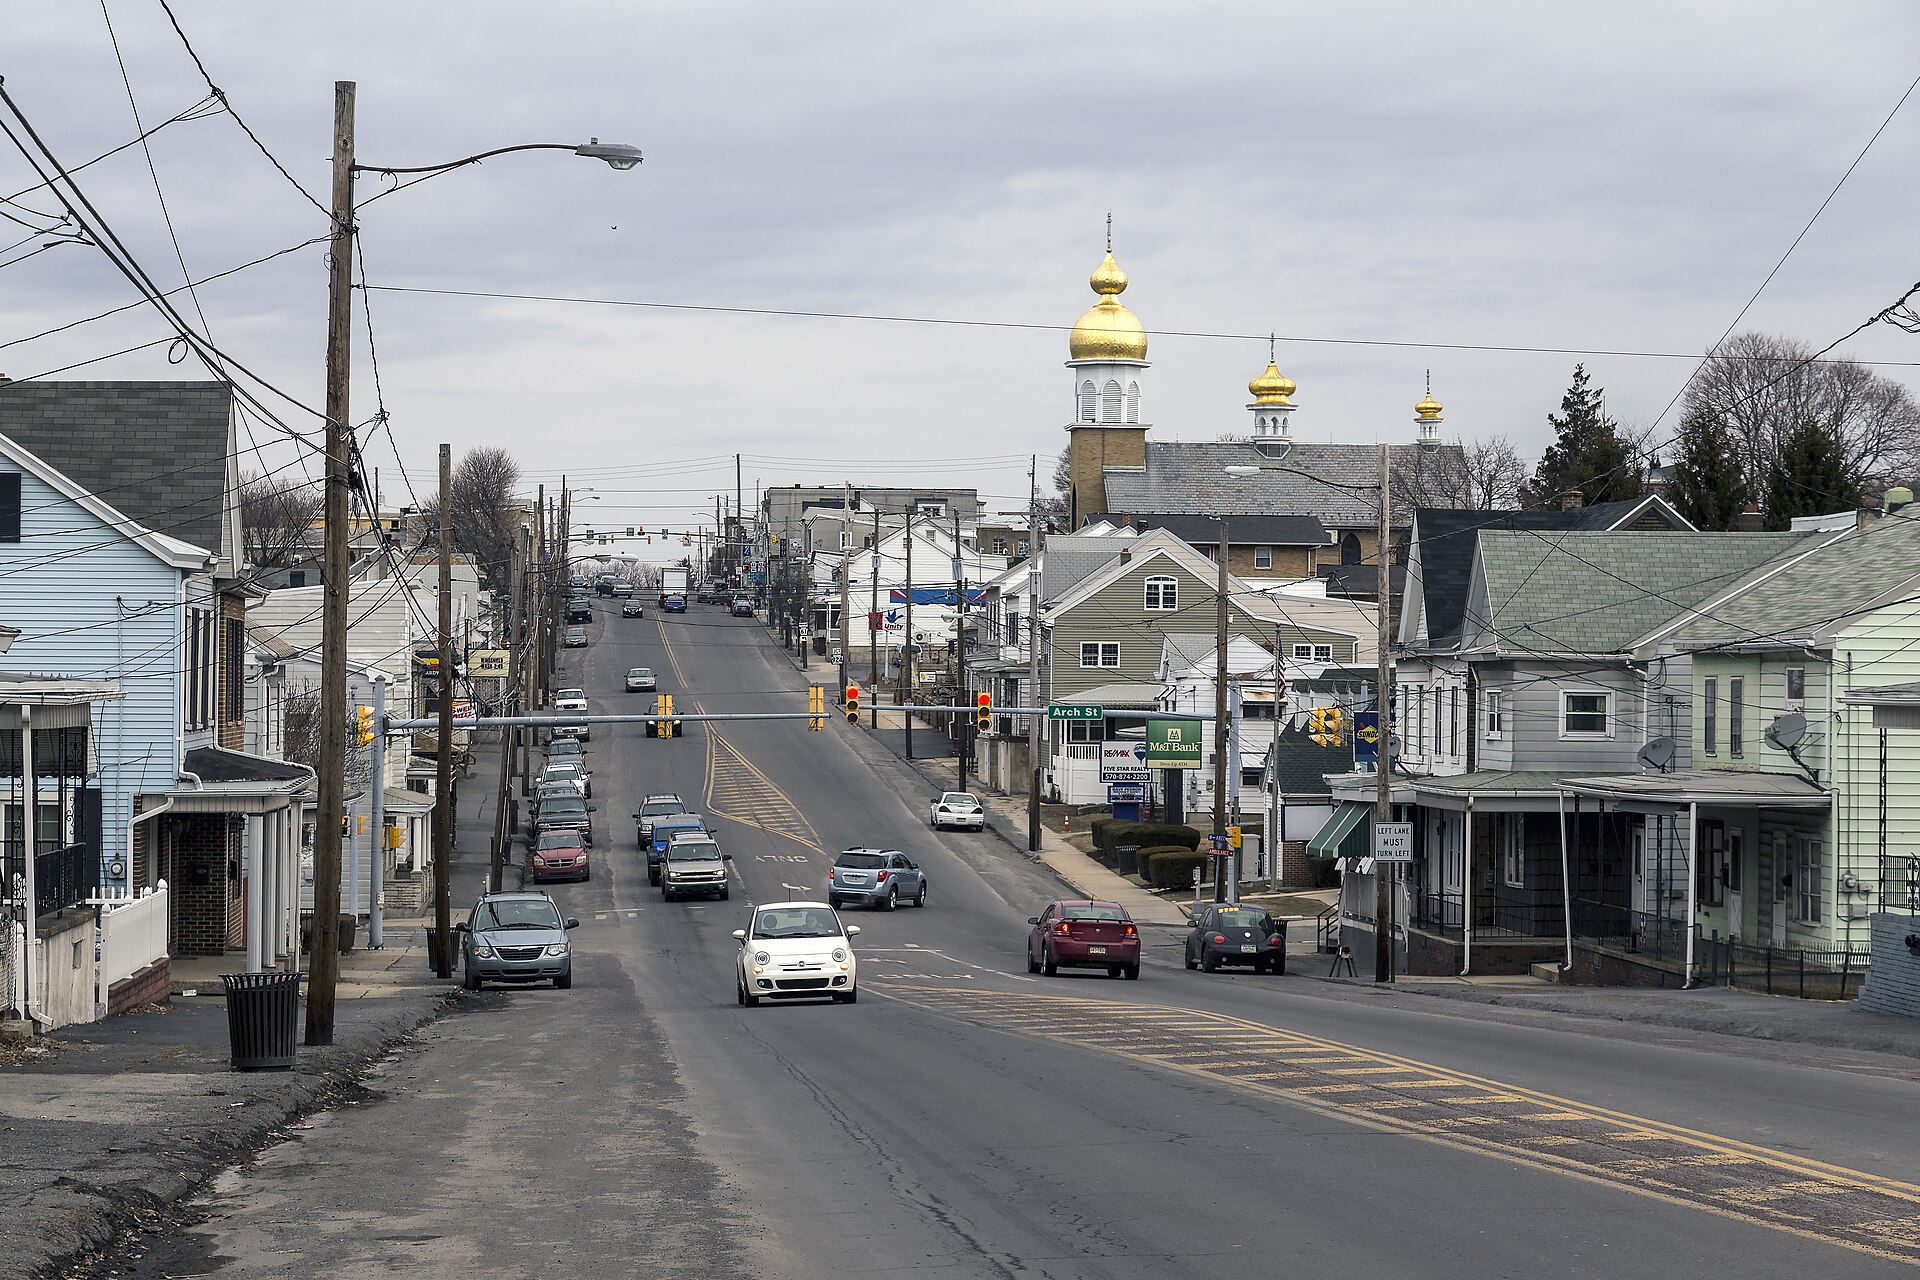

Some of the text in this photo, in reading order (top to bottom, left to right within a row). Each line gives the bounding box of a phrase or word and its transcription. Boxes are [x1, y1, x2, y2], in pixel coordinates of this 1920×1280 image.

[884, 623, 904, 631] Unity
[1053, 707, 1098, 717] Arch St
[1357, 730, 1379, 738] SUNOC
[1149, 742, 1172, 752] M&T
[1171, 742, 1199, 752] Bank
[1103, 749, 1131, 758] RE/MAX
[1377, 827, 1410, 835] LEFT LANE
[1383, 838, 1404, 847] MUST
